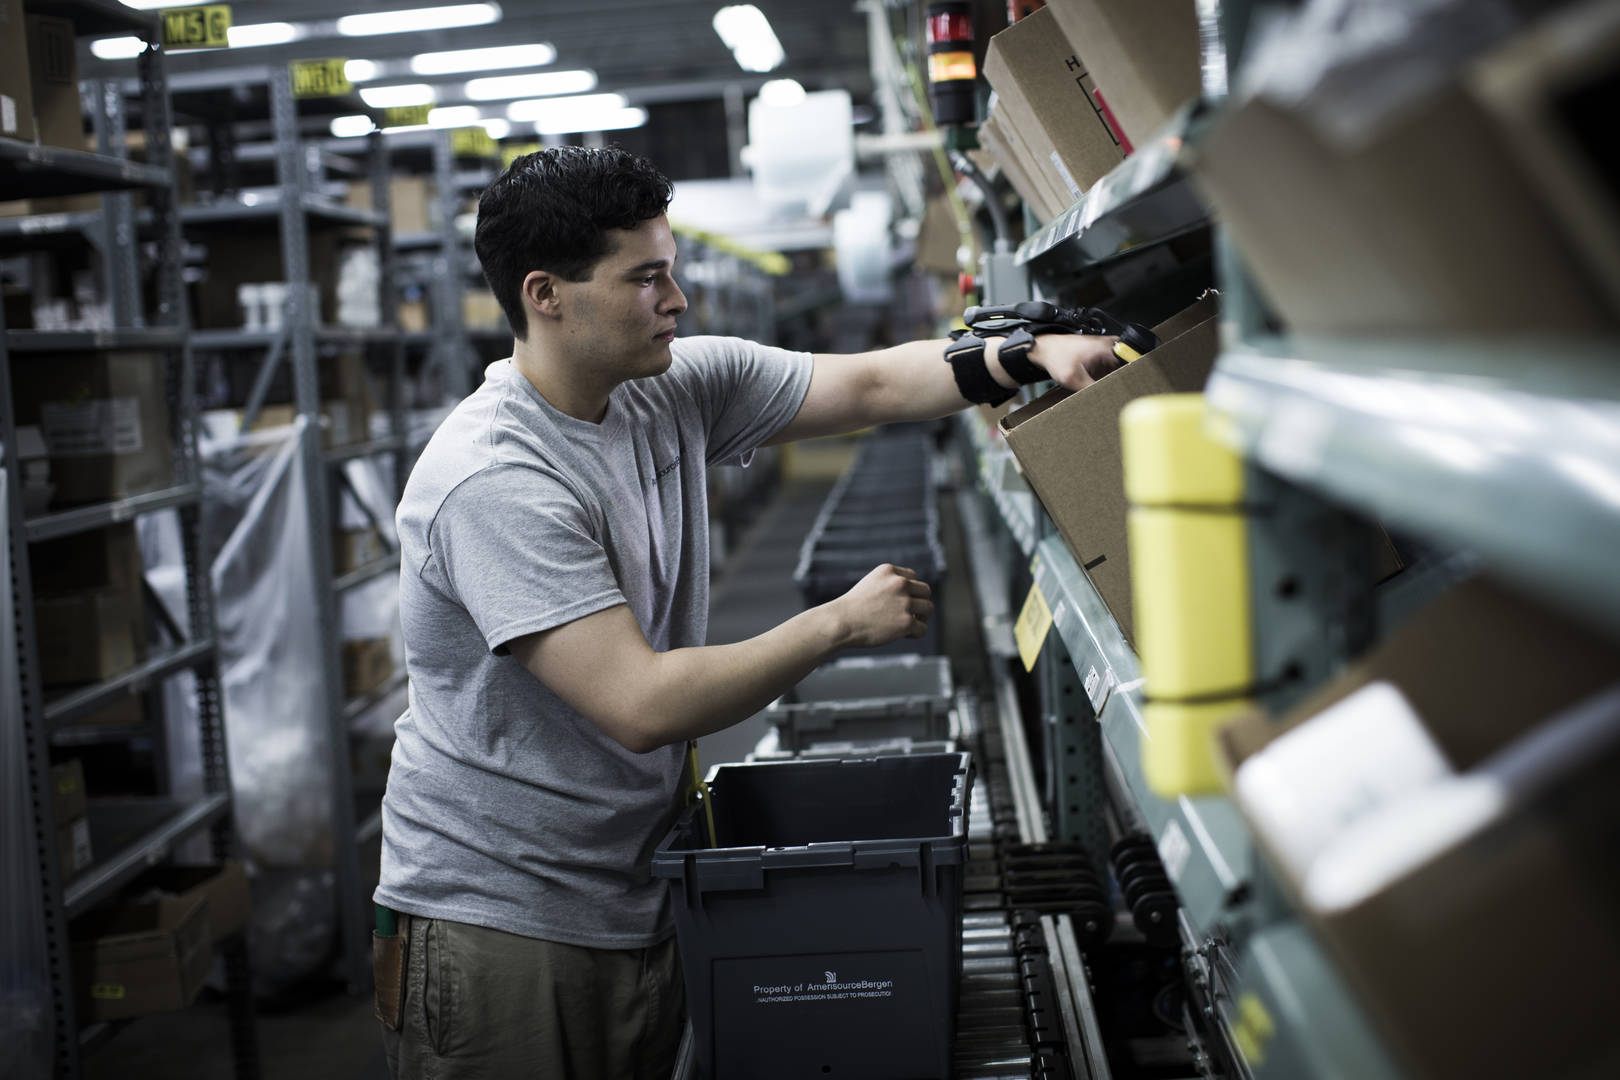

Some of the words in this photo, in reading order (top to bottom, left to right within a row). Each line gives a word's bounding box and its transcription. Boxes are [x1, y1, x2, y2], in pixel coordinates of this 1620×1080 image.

[1065, 55, 1081, 72] H
[753, 984, 792, 995] Property
[794, 983, 803, 992] of
[756, 995, 794, 1003] NAUTHORIZED
[849, 991, 857, 999] TO
